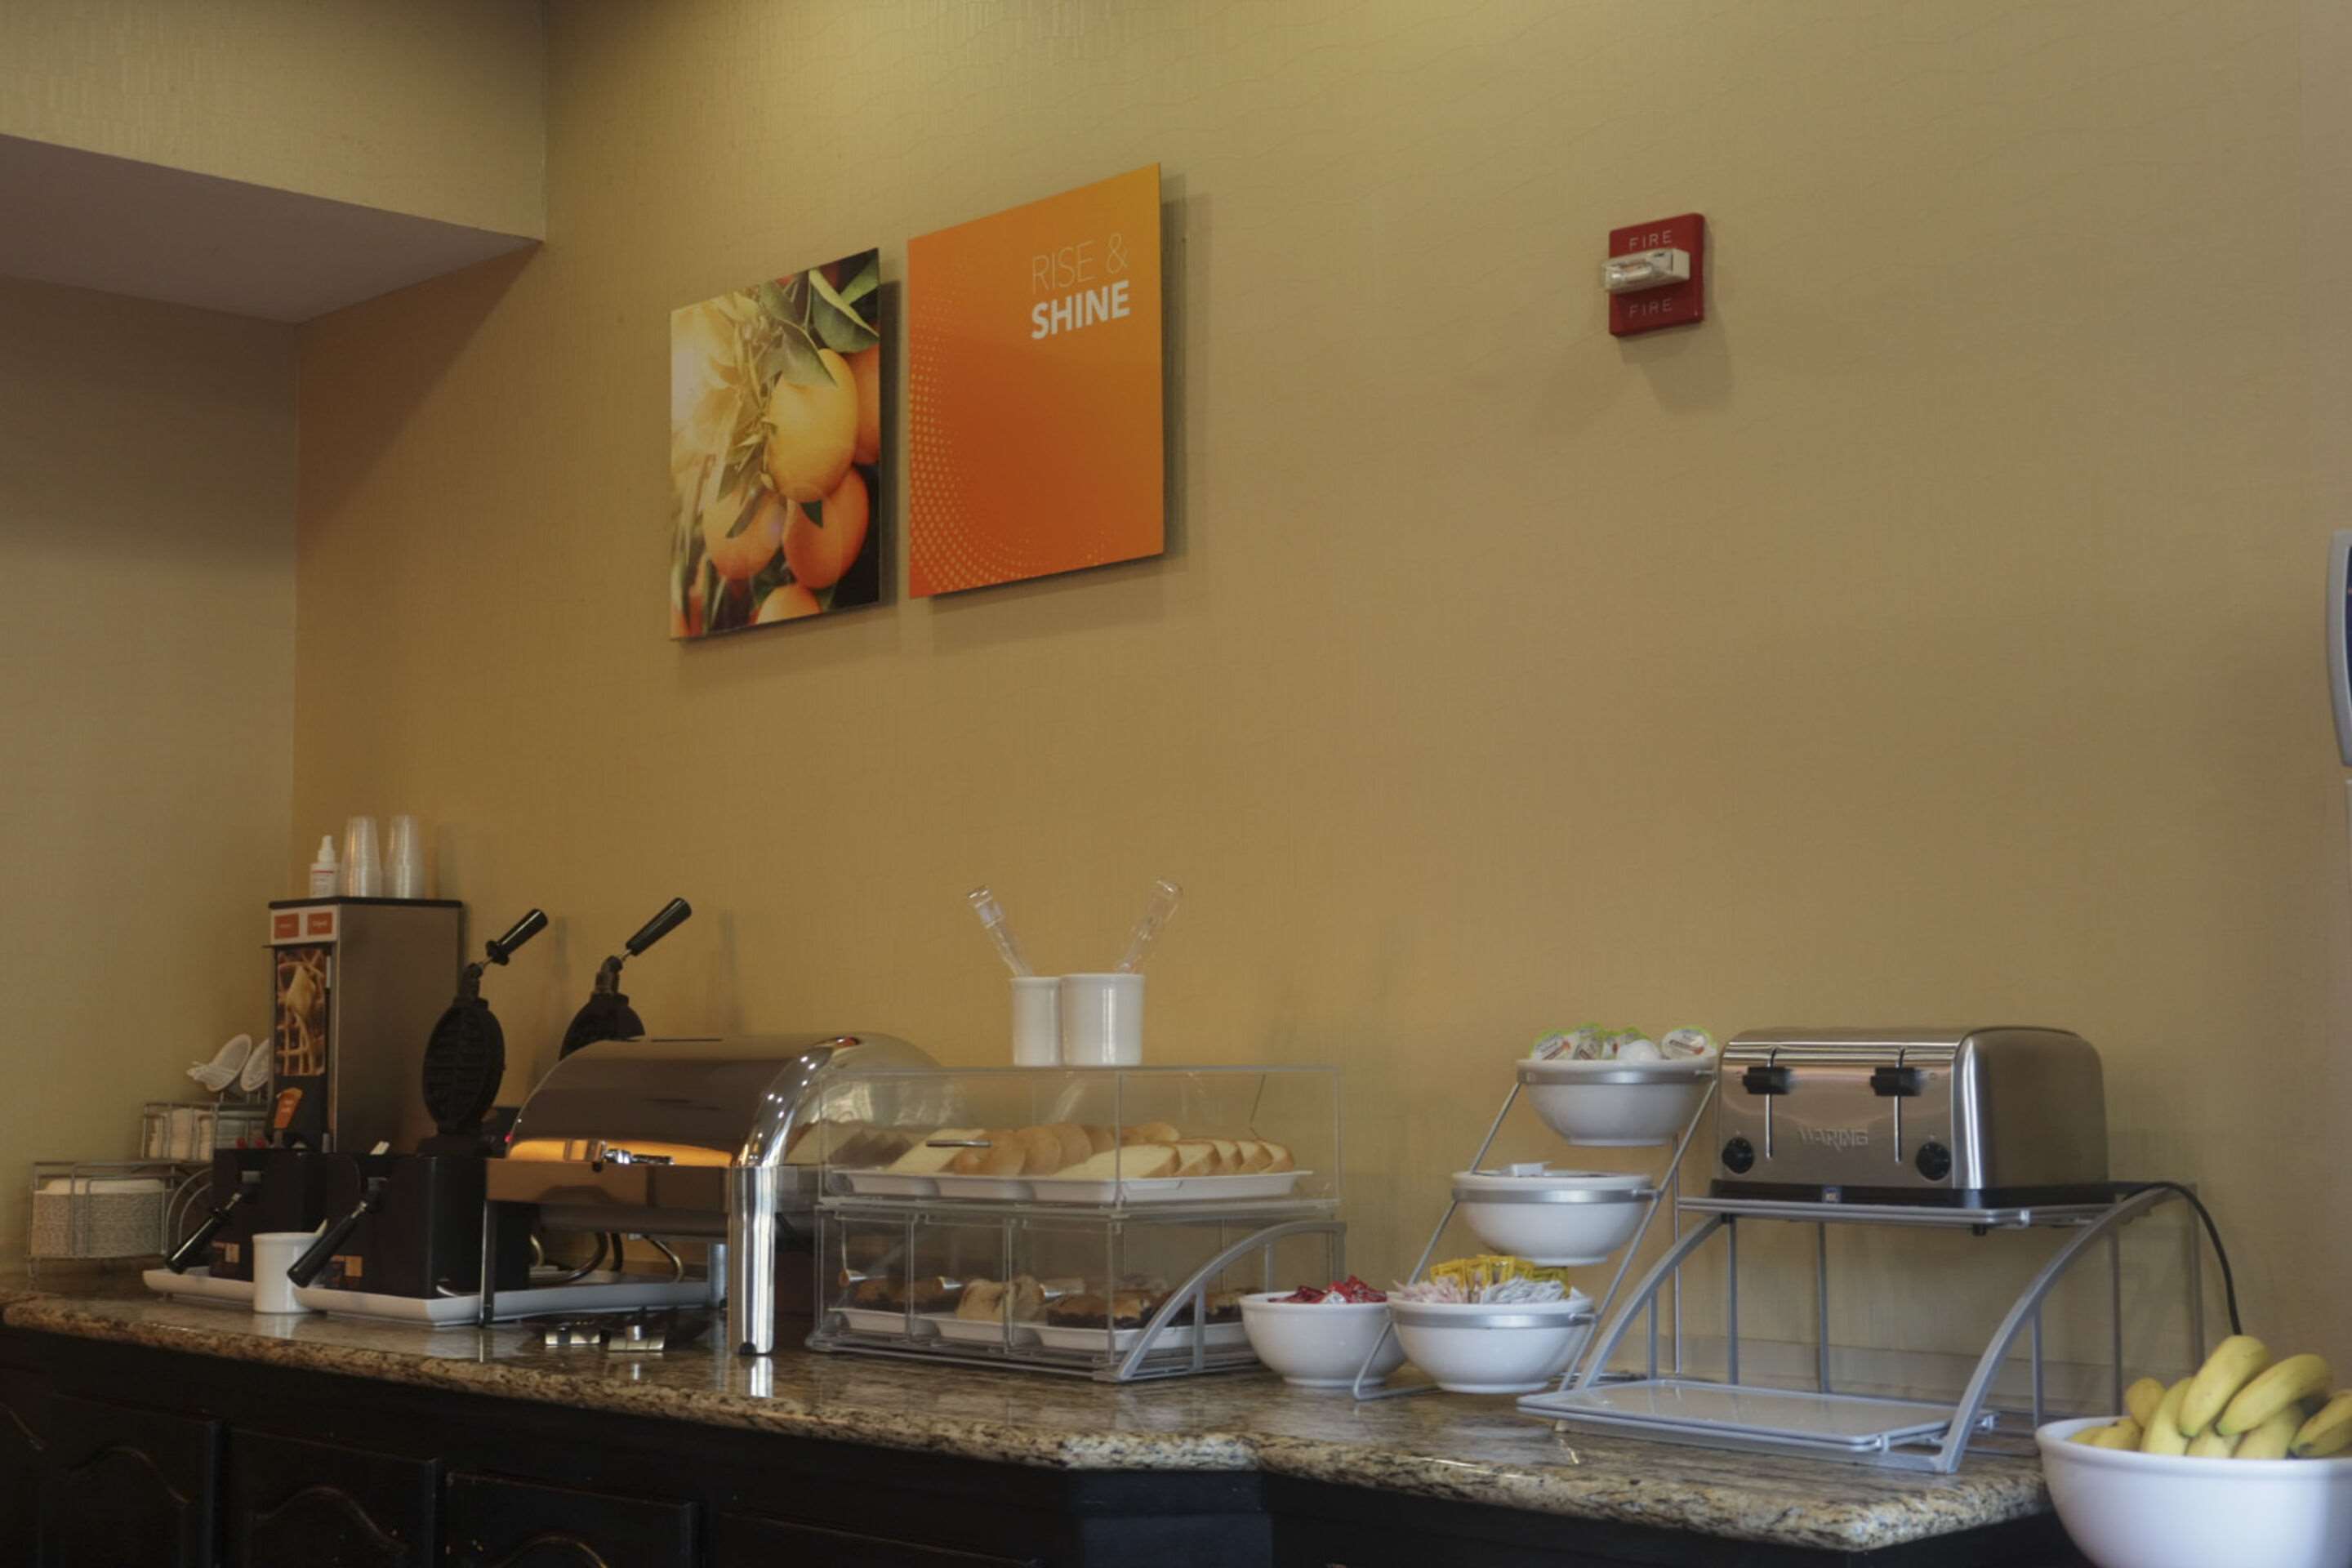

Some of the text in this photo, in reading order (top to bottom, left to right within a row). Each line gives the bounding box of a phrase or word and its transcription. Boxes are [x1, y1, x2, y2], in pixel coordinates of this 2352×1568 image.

[1628, 229, 1673, 251] FIRE
[1032, 233, 1129, 295] RISE &
[1031, 279, 1131, 339] SHINE
[1628, 298, 1673, 318] FIRE
